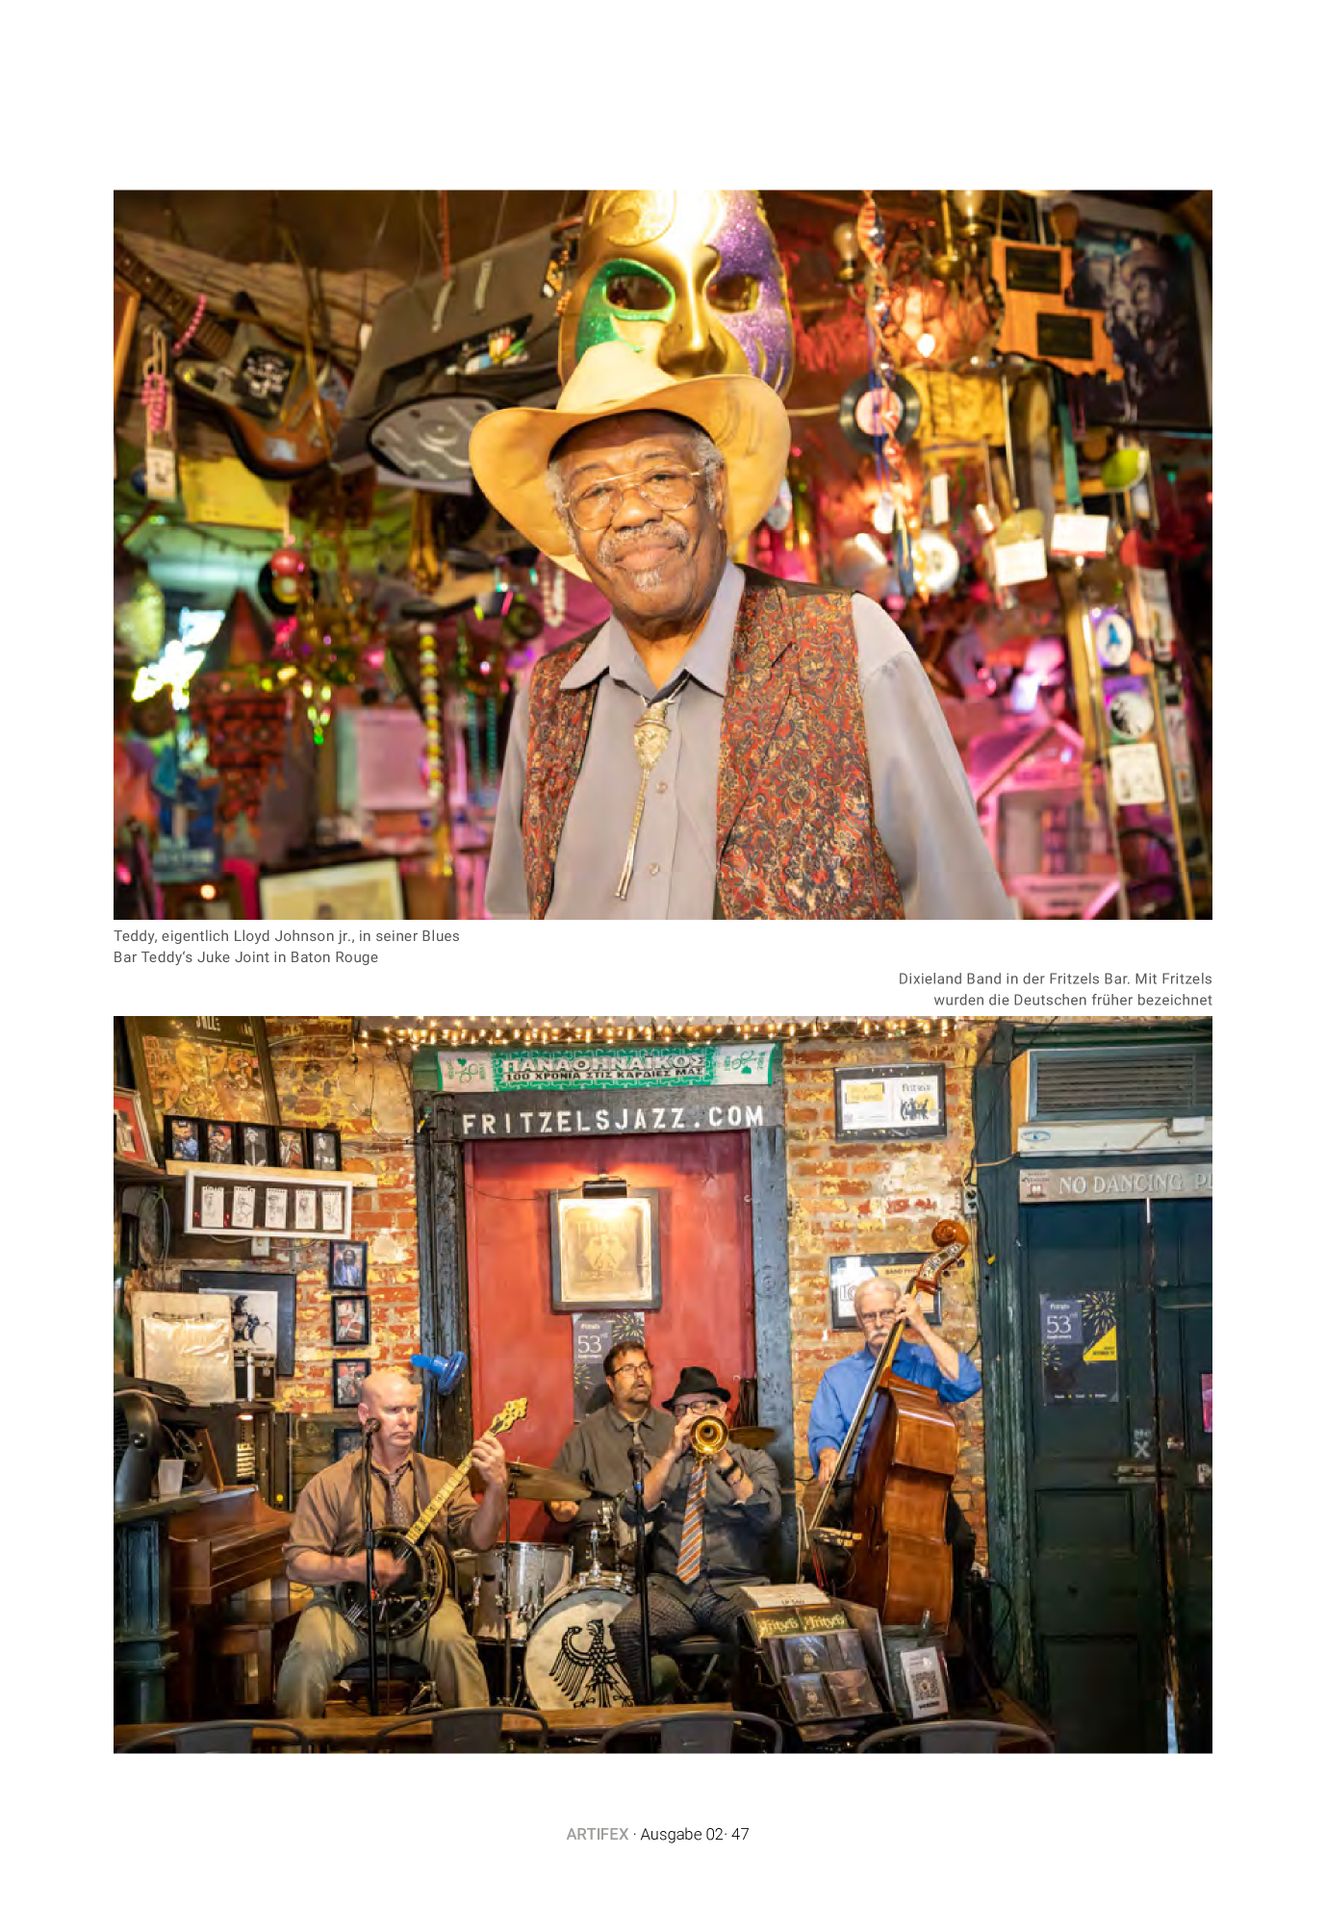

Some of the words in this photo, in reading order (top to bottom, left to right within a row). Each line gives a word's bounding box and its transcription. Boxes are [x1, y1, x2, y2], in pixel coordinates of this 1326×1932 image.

[507, 1073, 530, 1082] 100
[535, 1072, 581, 1081] ΧΡΟΝΙΑ
[586, 1071, 613, 1080] ΣΤΙΣ
[616, 1070, 671, 1079] ΚΑΡΔΙΕΣ
[675, 1068, 704, 1076] ΜΑΣ
[461, 1105, 764, 1135] FRITZELSJAZZ.COM
[1059, 1175, 1088, 1194] NO
[1094, 1173, 1183, 1193] DANCING
